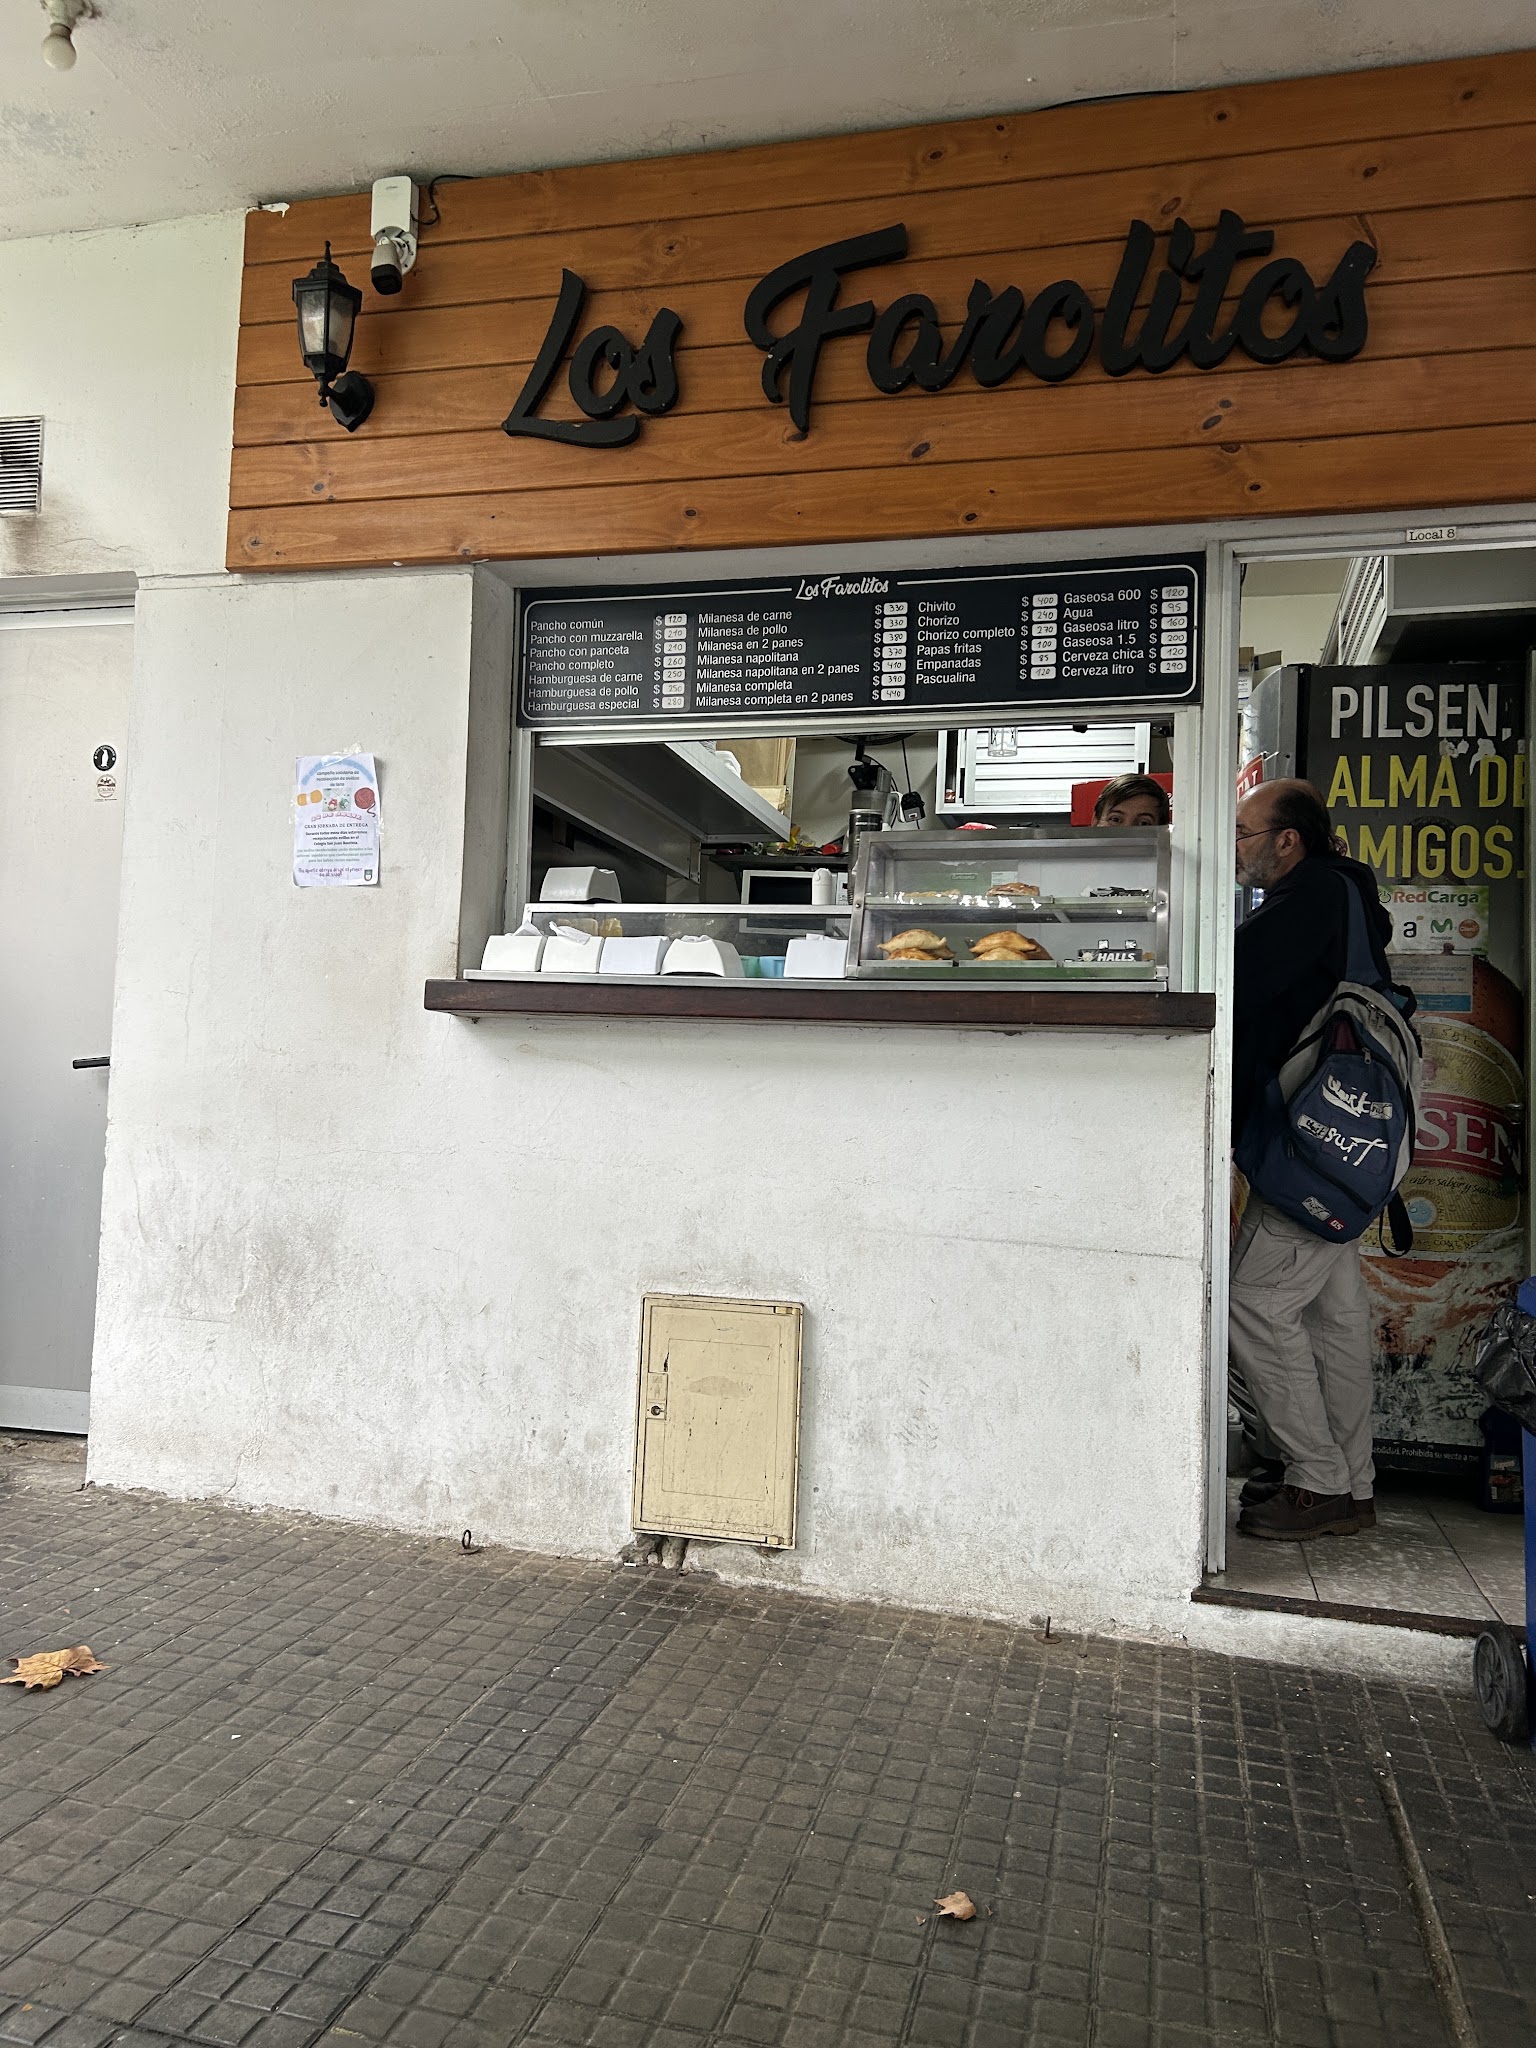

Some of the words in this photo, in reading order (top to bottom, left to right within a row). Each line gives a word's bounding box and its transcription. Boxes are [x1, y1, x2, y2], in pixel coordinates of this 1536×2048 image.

[502, 266, 684, 450] Los
[743, 209, 1379, 440] Farolitos
[1410, 530, 1442, 540] Local
[1447, 529, 1455, 538] 8
[795, 579, 819, 600] Los
[821, 576, 889, 598] Farolitos
[1166, 589, 1184, 597] 120
[1038, 597, 1053, 605] 400
[1064, 593, 1114, 604] Gaseosa
[1118, 589, 1141, 600] 600
[919, 601, 956, 612] Chivito
[1168, 603, 1181, 612] 95
[699, 613, 743, 623] Milanesa
[747, 611, 759, 621] de
[763, 611, 792, 620] carne
[1038, 611, 1053, 619] 240
[1063, 608, 1093, 620] Agua
[531, 621, 566, 631] Pancho
[570, 619, 603, 629] común
[918, 615, 959, 627] Chorizo
[1064, 622, 1113, 633] Gaseosa
[1118, 620, 1139, 630] litro
[698, 627, 743, 637] Milanesa
[747, 625, 759, 635] de
[763, 624, 787, 636] pollo
[918, 630, 959, 641] Chorizo
[963, 627, 1015, 639] completo
[1037, 626, 1053, 634] 270
[531, 635, 566, 644] Pancho
[570, 635, 587, 643] con
[591, 631, 643, 642] muzzarella
[1063, 637, 1113, 647] Gaseosa
[1118, 634, 1136, 644] 1.5
[530, 648, 565, 657] Pancho
[569, 648, 587, 656] con
[590, 645, 629, 657] panceta
[698, 641, 743, 651] Milanesa
[746, 640, 758, 650] en
[762, 639, 768, 648] 2
[772, 638, 803, 650] panes
[917, 645, 950, 657] Papas
[954, 643, 982, 653] fritas
[697, 655, 742, 665] Milanesa
[746, 652, 799, 663] napolitana
[1063, 651, 1108, 662] Cerveza
[1113, 648, 1144, 660] chica
[530, 661, 565, 671] Pancho
[569, 660, 614, 670] completo
[916, 657, 981, 671] Empanadas
[1062, 666, 1108, 677] Cerveza
[1112, 664, 1134, 674] litro
[1166, 662, 1183, 670] 290
[697, 668, 742, 679] Milanesa
[746, 666, 798, 678] napolitana
[802, 665, 814, 675] en
[818, 664, 824, 674] 2
[828, 664, 859, 676] panes
[916, 672, 975, 684] Pascualina
[529, 675, 597, 685] Hamburguesa
[600, 673, 611, 682] de
[615, 673, 643, 681] carne
[529, 688, 596, 699] Hamburguesa
[600, 687, 611, 696] de
[615, 686, 638, 697] pollo
[696, 682, 741, 693] Milanesa
[745, 680, 792, 693] completa
[528, 701, 595, 712] Hamburguesa
[599, 699, 640, 710] especial
[696, 696, 741, 706] Milanesa
[745, 693, 794, 706] completa
[795, 694, 807, 703] en
[811, 692, 818, 702] 2
[822, 692, 853, 703] panes
[1331, 684, 1512, 741] PILSEN,
[1326, 755, 1461, 808] ALMA
[1394, 891, 1479, 906] RedCarga
[1097, 953, 1135, 961] HALLS
[1415, 1107, 1520, 1174] SEN
[1401, 1447, 1434, 1458] Prohibida
